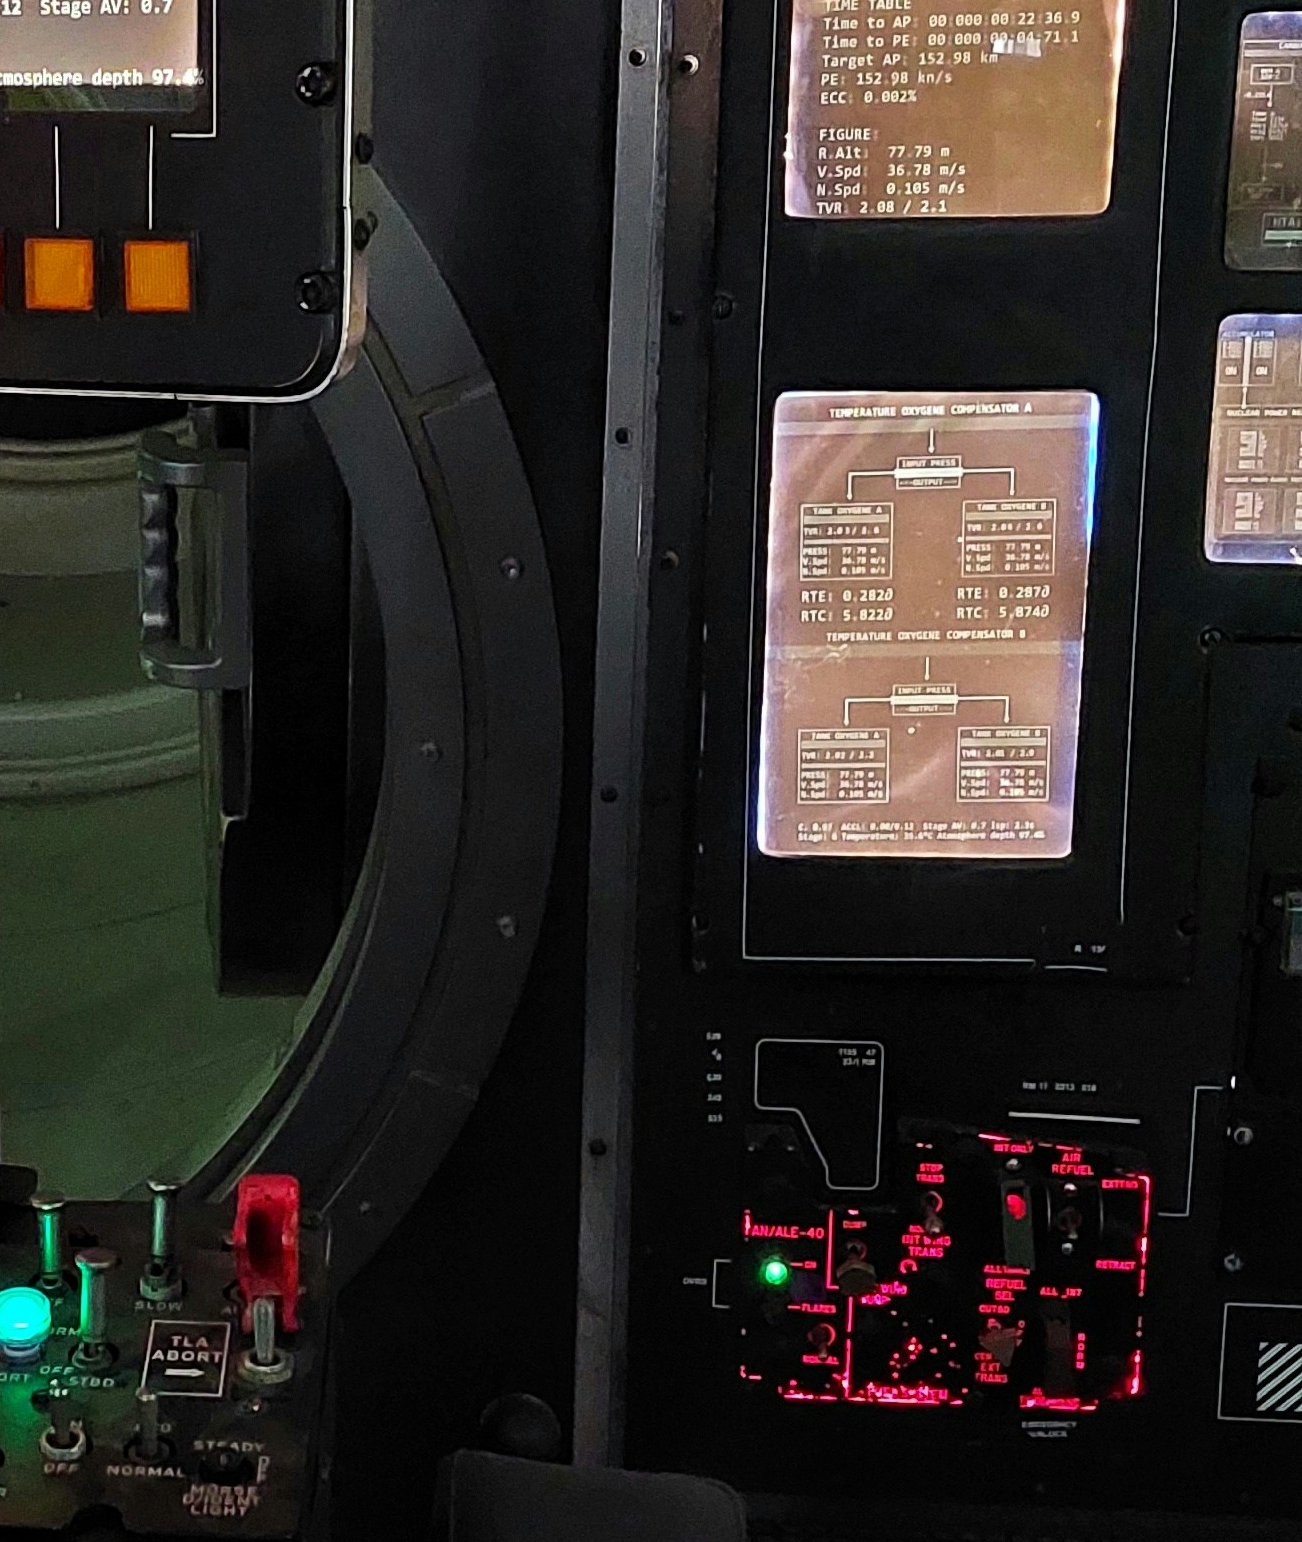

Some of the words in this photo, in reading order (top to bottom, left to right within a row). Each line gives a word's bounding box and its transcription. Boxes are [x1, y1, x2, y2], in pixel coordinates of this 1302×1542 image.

[825, 0, 859, 12] TIME
[824, 18, 858, 30] Time
[867, 17, 884, 29] to
[92, 69, 143, 88] depth
[887, 164, 931, 176] 36.78
[939, 163, 966, 176] m/s
[1062, 1153, 1082, 1163] AIR
[1052, 1163, 1094, 1176] REFUEL
[751, 1224, 825, 1240] AN/ALE-40
[134, 1300, 184, 1311] SLOW
[170, 1335, 209, 1348] TLA
[151, 1349, 223, 1364] ABORT
[39, 1366, 75, 1376] OFF
[44, 1463, 80, 1475] OFF
[106, 1464, 186, 1478] NORMAL
